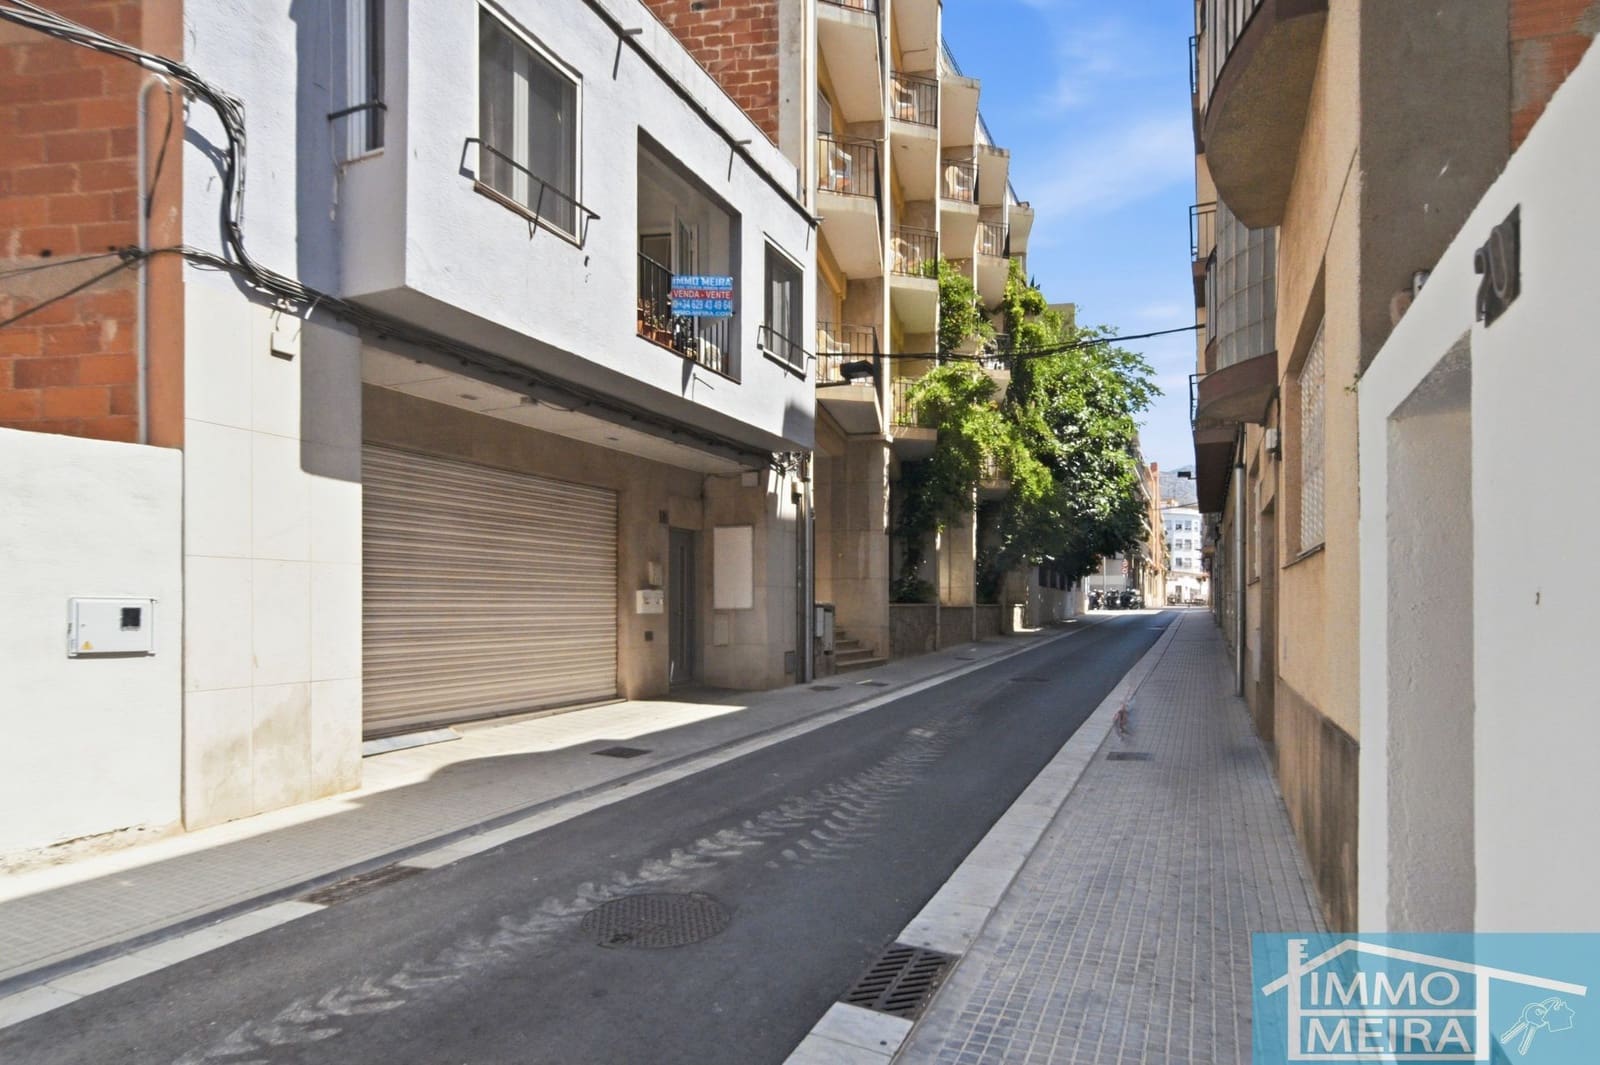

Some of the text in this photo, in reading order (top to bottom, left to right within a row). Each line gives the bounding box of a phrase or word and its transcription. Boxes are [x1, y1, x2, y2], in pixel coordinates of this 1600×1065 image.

[672, 277, 731, 287] IMMO MEIRA
[673, 290, 700, 298] VENDA
[705, 291, 731, 299] VENTE
